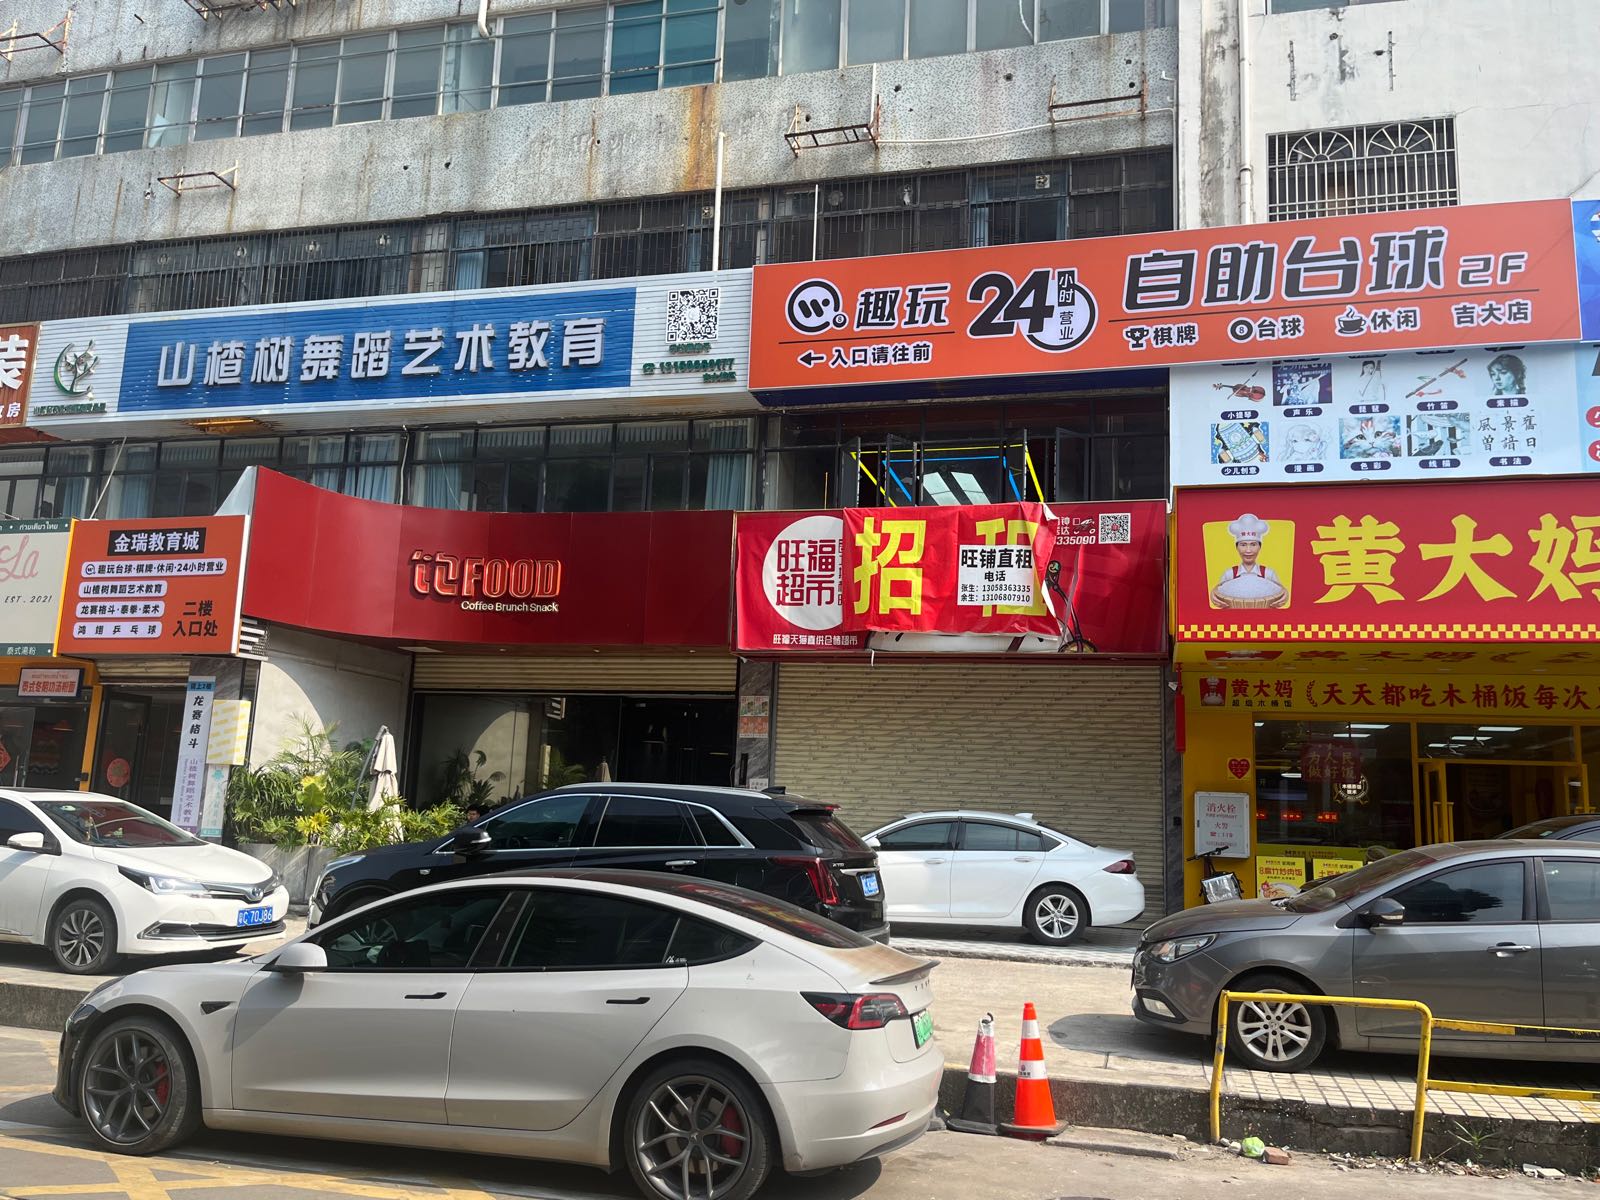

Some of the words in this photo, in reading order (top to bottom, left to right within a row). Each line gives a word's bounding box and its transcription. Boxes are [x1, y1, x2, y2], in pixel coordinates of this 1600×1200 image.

[1126, 229, 1446, 310] 自助台球
[1461, 253, 1527, 285] 2F
[1059, 273, 1074, 303] 小时
[857, 285, 949, 328] 趣玩
[968, 270, 1054, 336] 24
[1455, 302, 1531, 325] 吉大店
[1059, 310, 1074, 341] 营业
[1258, 318, 1303, 340] 台球
[1371, 309, 1417, 331] 休闲
[1153, 323, 1198, 346] 棋牌
[156, 317, 606, 388] 山楂树舞蹈艺术教育
[831, 343, 931, 366] 入口请往前
[1227, 411, 1252, 420] 小提琴
[1292, 408, 1314, 417] 声乐
[1426, 402, 1448, 410] 竹笛
[1224, 466, 1258, 476] 少儿创意
[1499, 457, 1522, 466] 书法
[114, 531, 200, 553] 金瑞教育城
[777, 539, 836, 573] 旺福
[961, 548, 1033, 569] 旺铺直租
[1310, 512, 1600, 605] 黄大妈
[984, 570, 1006, 582] 电话
[30, 594, 53, 603] 2021
[83, 583, 163, 595] 山楂树舞蹈艺术教育
[775, 573, 835, 606] 超市
[183, 600, 213, 617] 二楼
[461, 601, 494, 611] Coffee
[495, 602, 529, 612] Brunch
[529, 603, 559, 613] Snack
[173, 619, 218, 637] 入口处
[772, 633, 858, 646] 旺福天猫直供仓储超市
[1231, 679, 1293, 698] 黄大妈
[1323, 680, 1600, 711] 天天都吃木桶饭每次
[188, 695, 204, 748] 龙赛格斗
[1207, 803, 1236, 813] 消火栓
